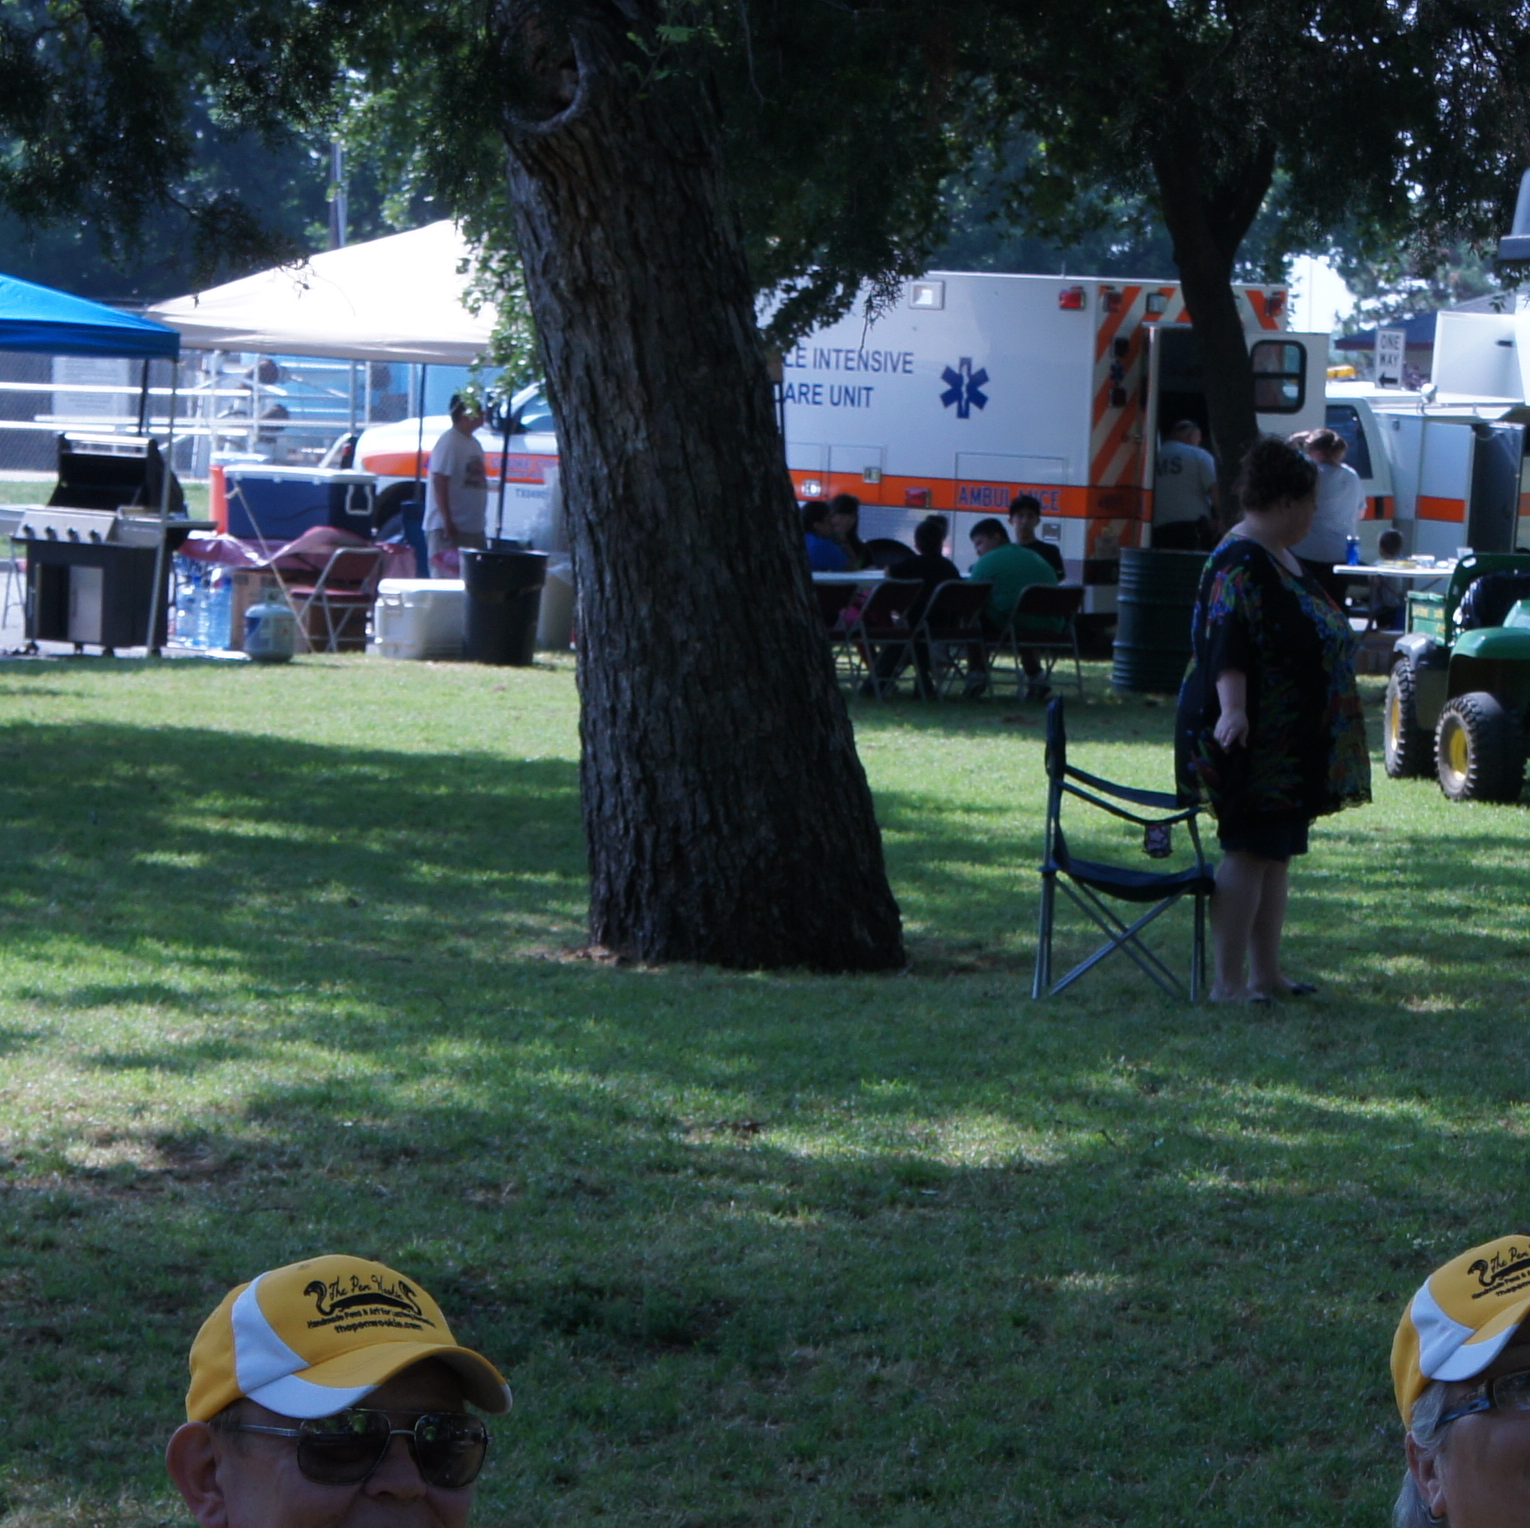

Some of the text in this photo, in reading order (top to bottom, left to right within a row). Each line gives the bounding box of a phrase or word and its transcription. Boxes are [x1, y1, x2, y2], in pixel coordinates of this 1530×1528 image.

[1379, 333, 1400, 350] ONE
[813, 348, 915, 374] INTENSIVE
[1379, 353, 1400, 367] WAY
[777, 382, 874, 408] ARE UNIT
[1155, 456, 1183, 477] MS
[957, 485, 1062, 512] AMBULNCE
